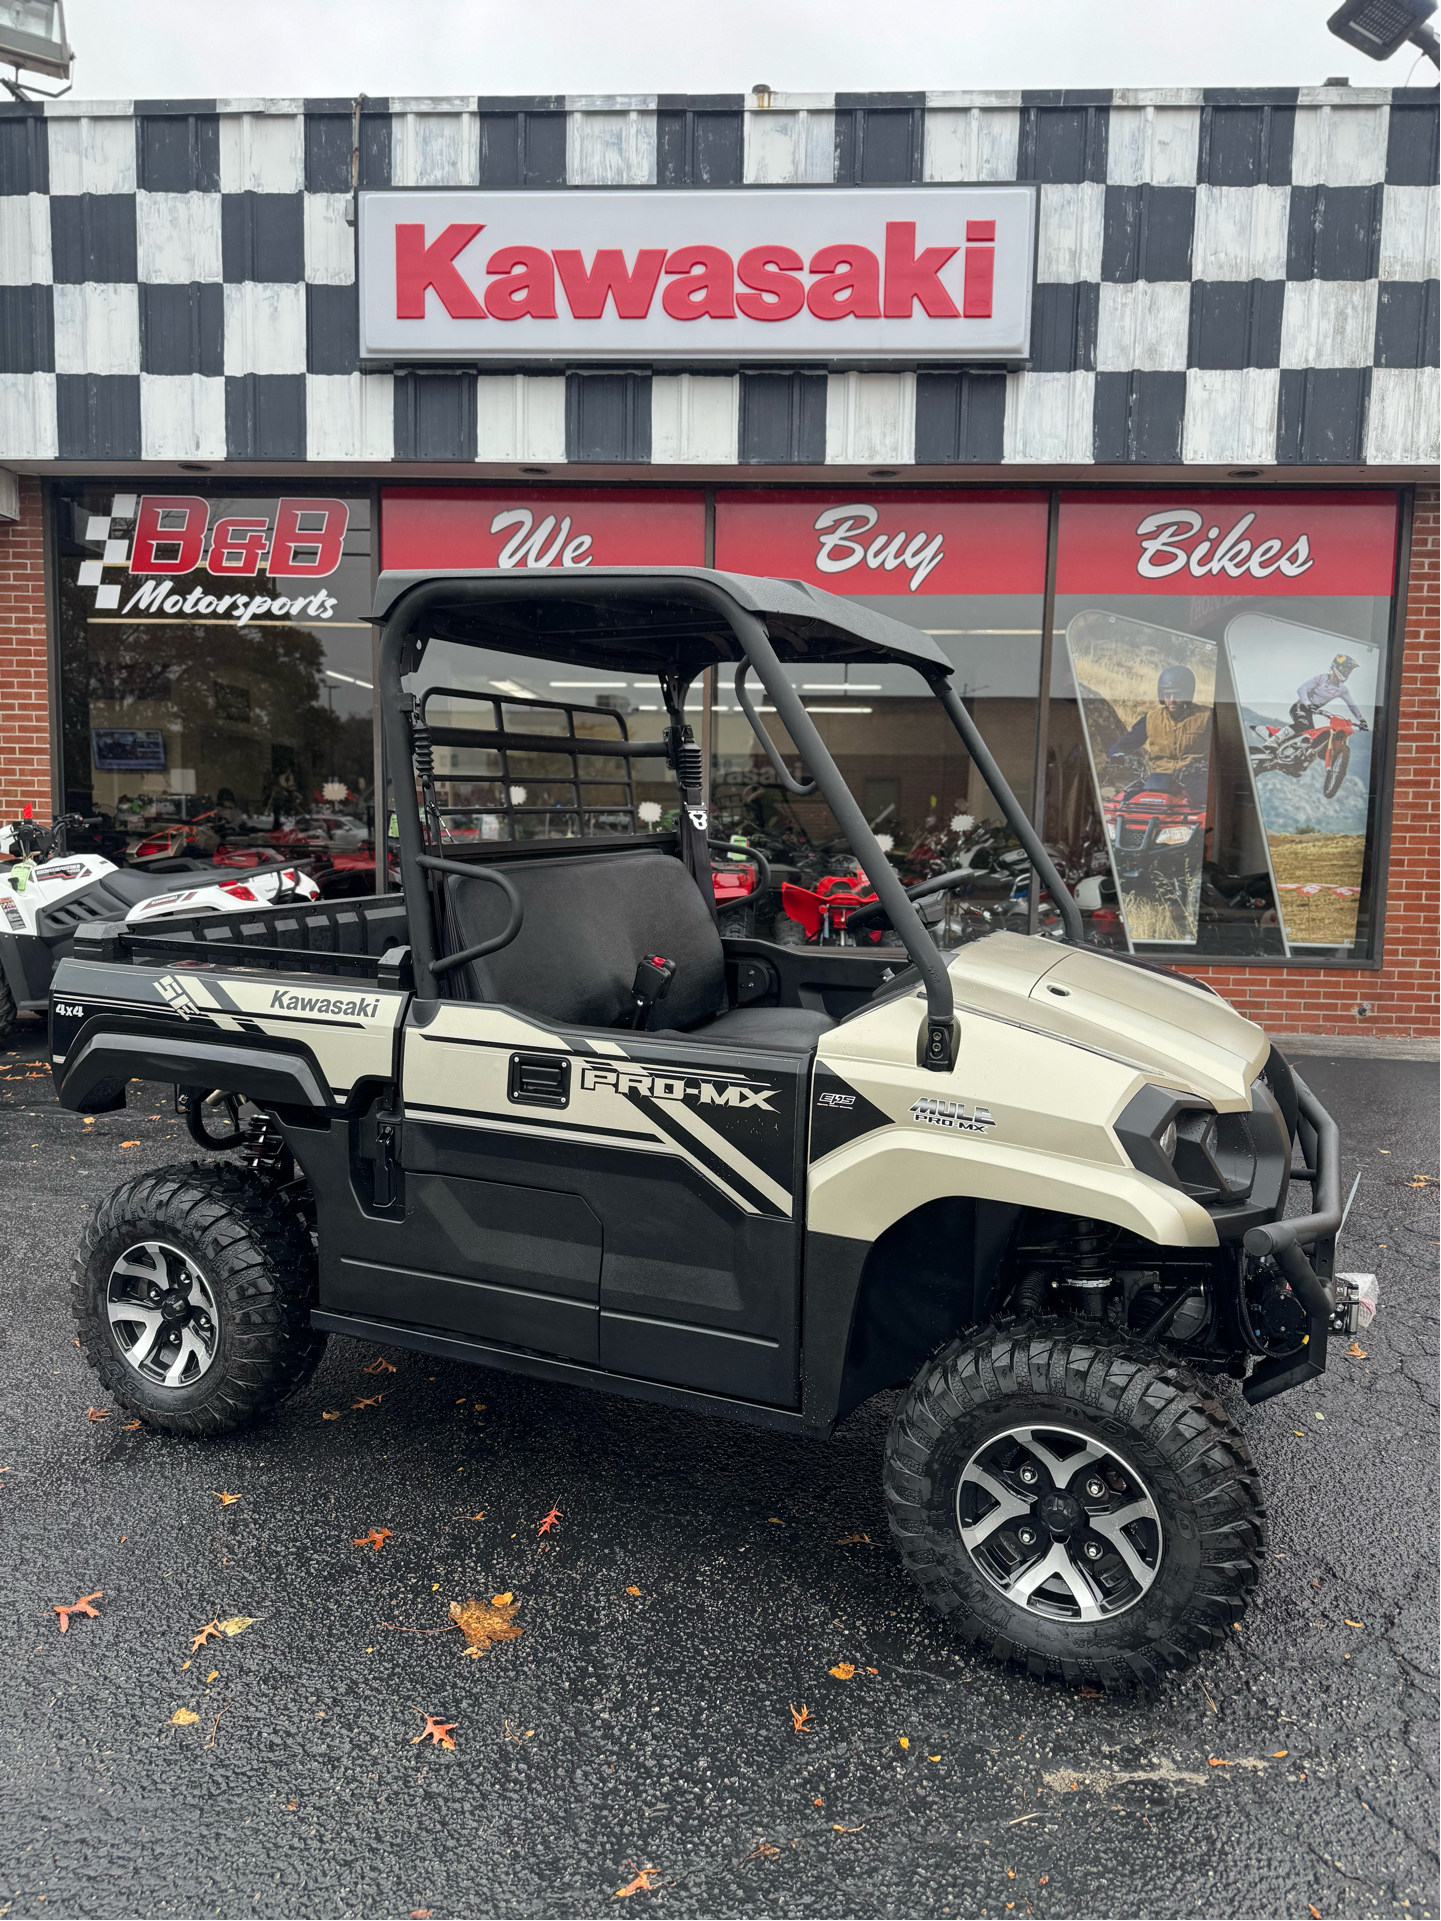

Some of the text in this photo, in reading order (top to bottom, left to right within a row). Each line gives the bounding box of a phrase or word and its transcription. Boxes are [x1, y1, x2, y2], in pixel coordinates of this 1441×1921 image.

[395, 219, 997, 322] Kawasaki
[128, 495, 350, 578] B&B
[489, 502, 1315, 593] We Buy Bikes
[121, 579, 339, 627] Motorsports
[55, 1003, 85, 1018] 4x4
[269, 990, 381, 1018] Kawasaki
[581, 1067, 783, 1114] PRO-MX
[908, 1097, 997, 1127] MULE
[913, 1113, 990, 1135] PRO-MX
